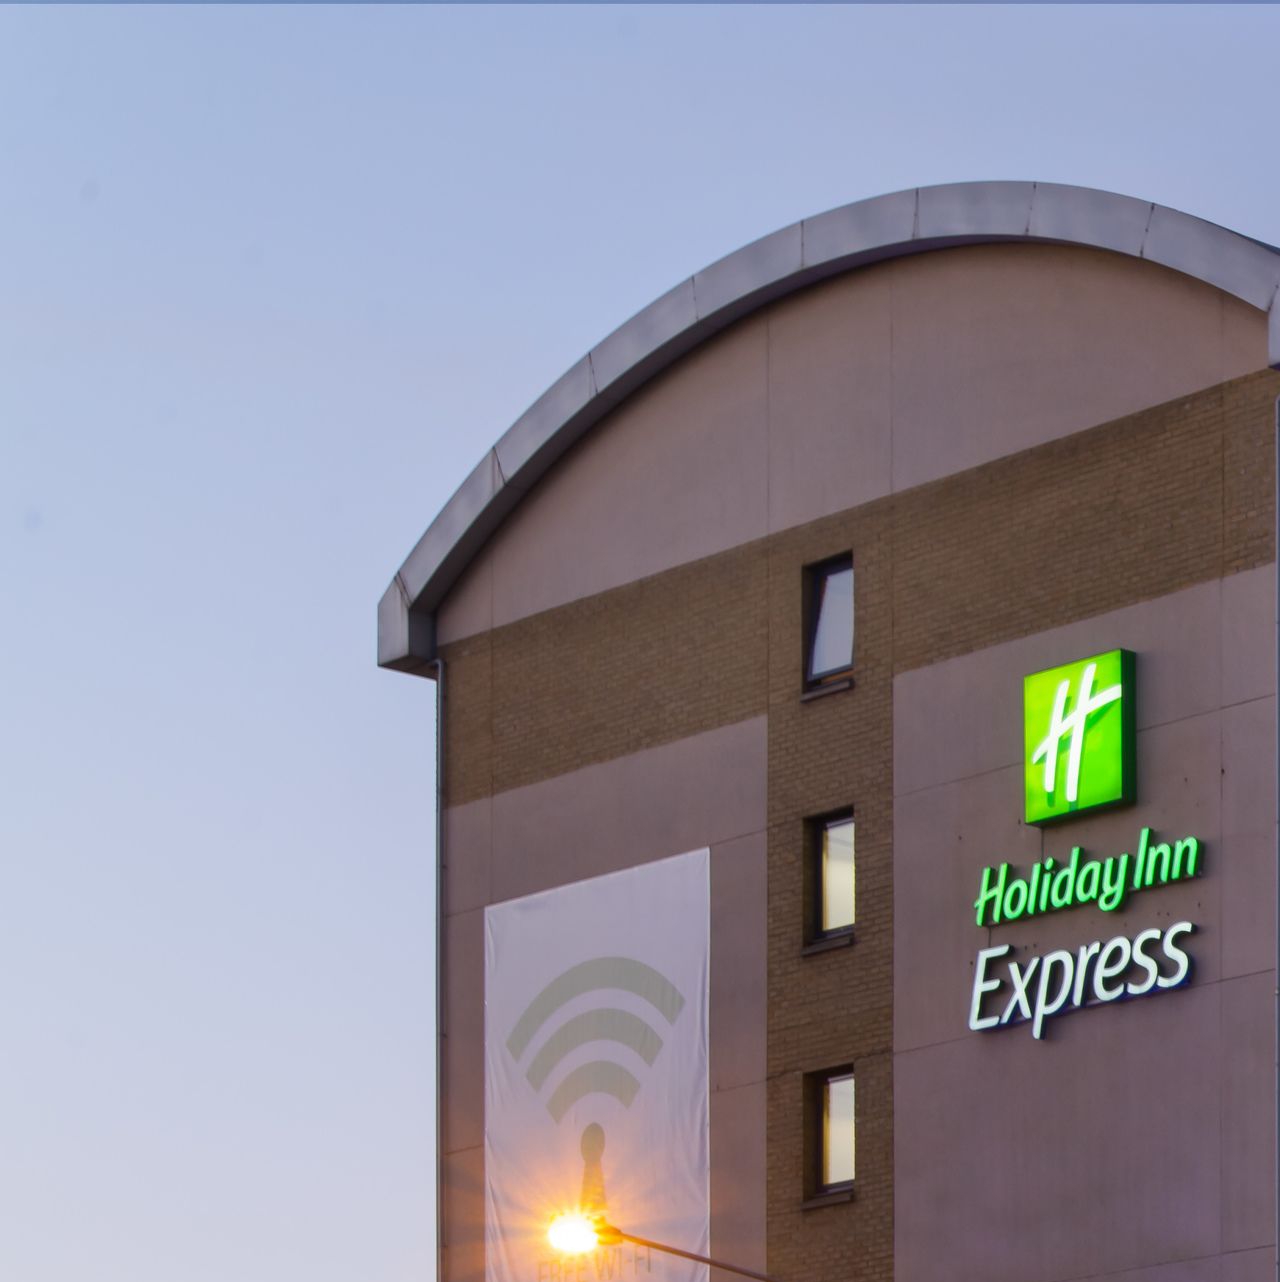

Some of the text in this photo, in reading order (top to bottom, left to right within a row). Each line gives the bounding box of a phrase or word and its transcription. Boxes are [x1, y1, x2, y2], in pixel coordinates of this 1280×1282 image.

[974, 827, 1199, 926] Holiday Inn
[969, 920, 1193, 1040] Express
